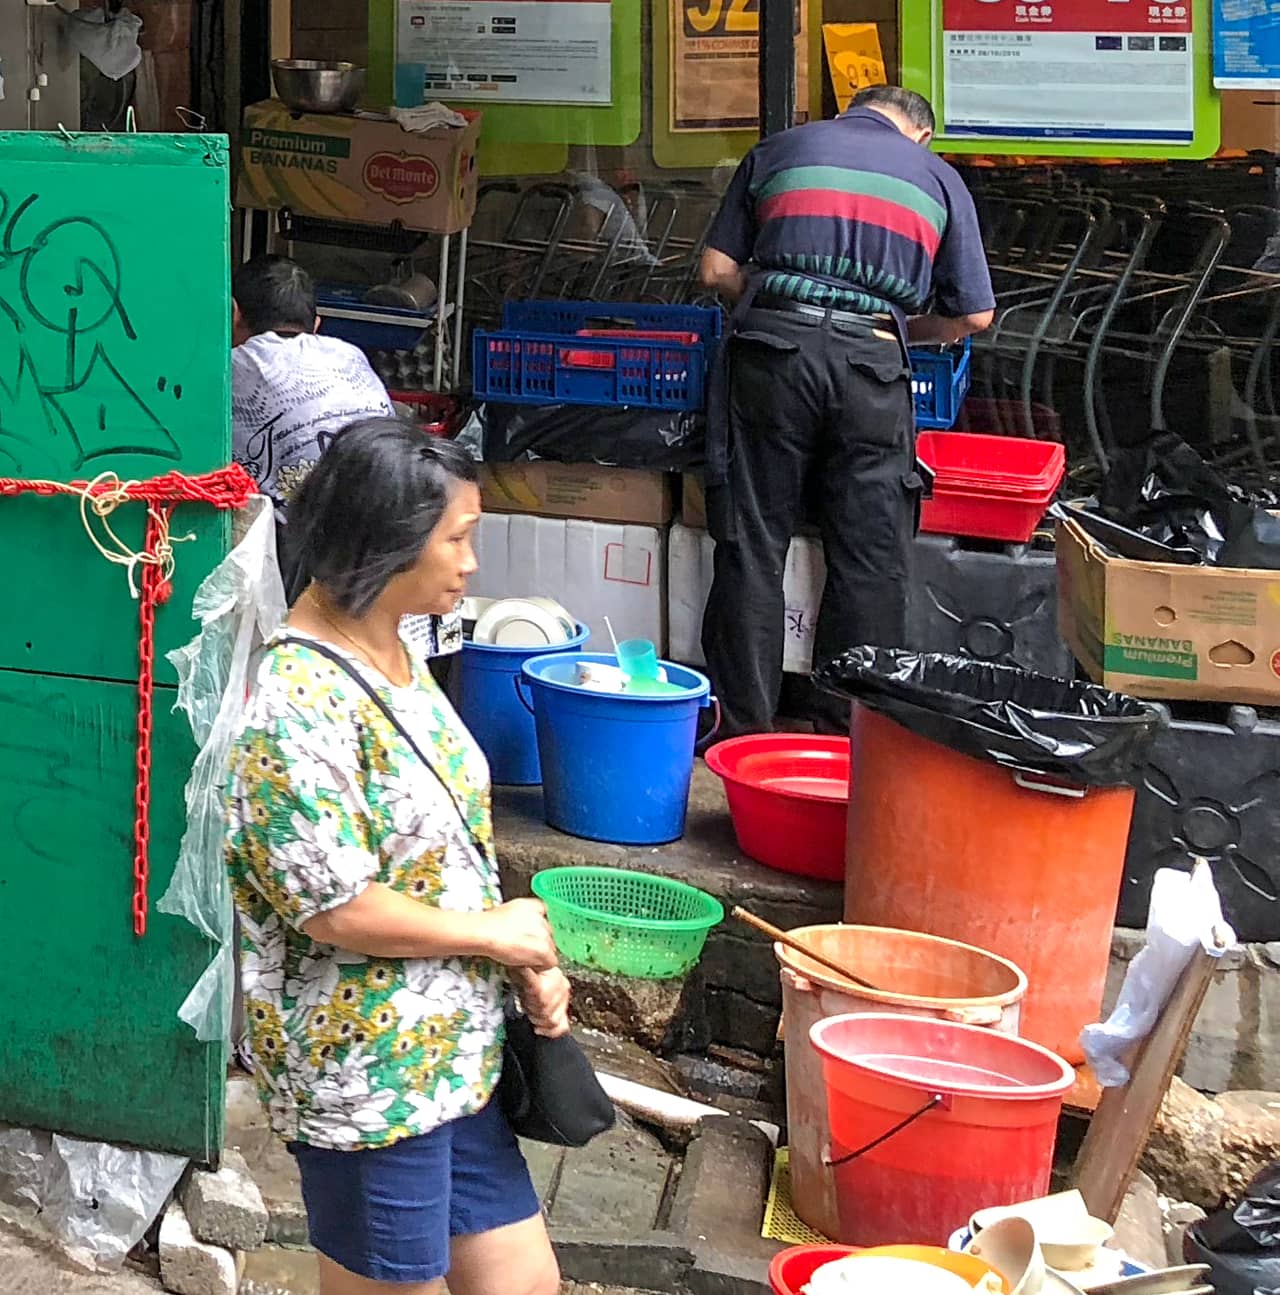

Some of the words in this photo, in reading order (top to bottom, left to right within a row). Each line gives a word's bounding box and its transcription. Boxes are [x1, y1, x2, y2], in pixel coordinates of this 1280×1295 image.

[251, 130, 327, 153] Premium
[250, 151, 338, 175] BANANAS
[370, 164, 391, 180] Del
[392, 165, 435, 185] Monte
[1112, 632, 1193, 652] BANANAS
[1123, 648, 1193, 668] Premium
